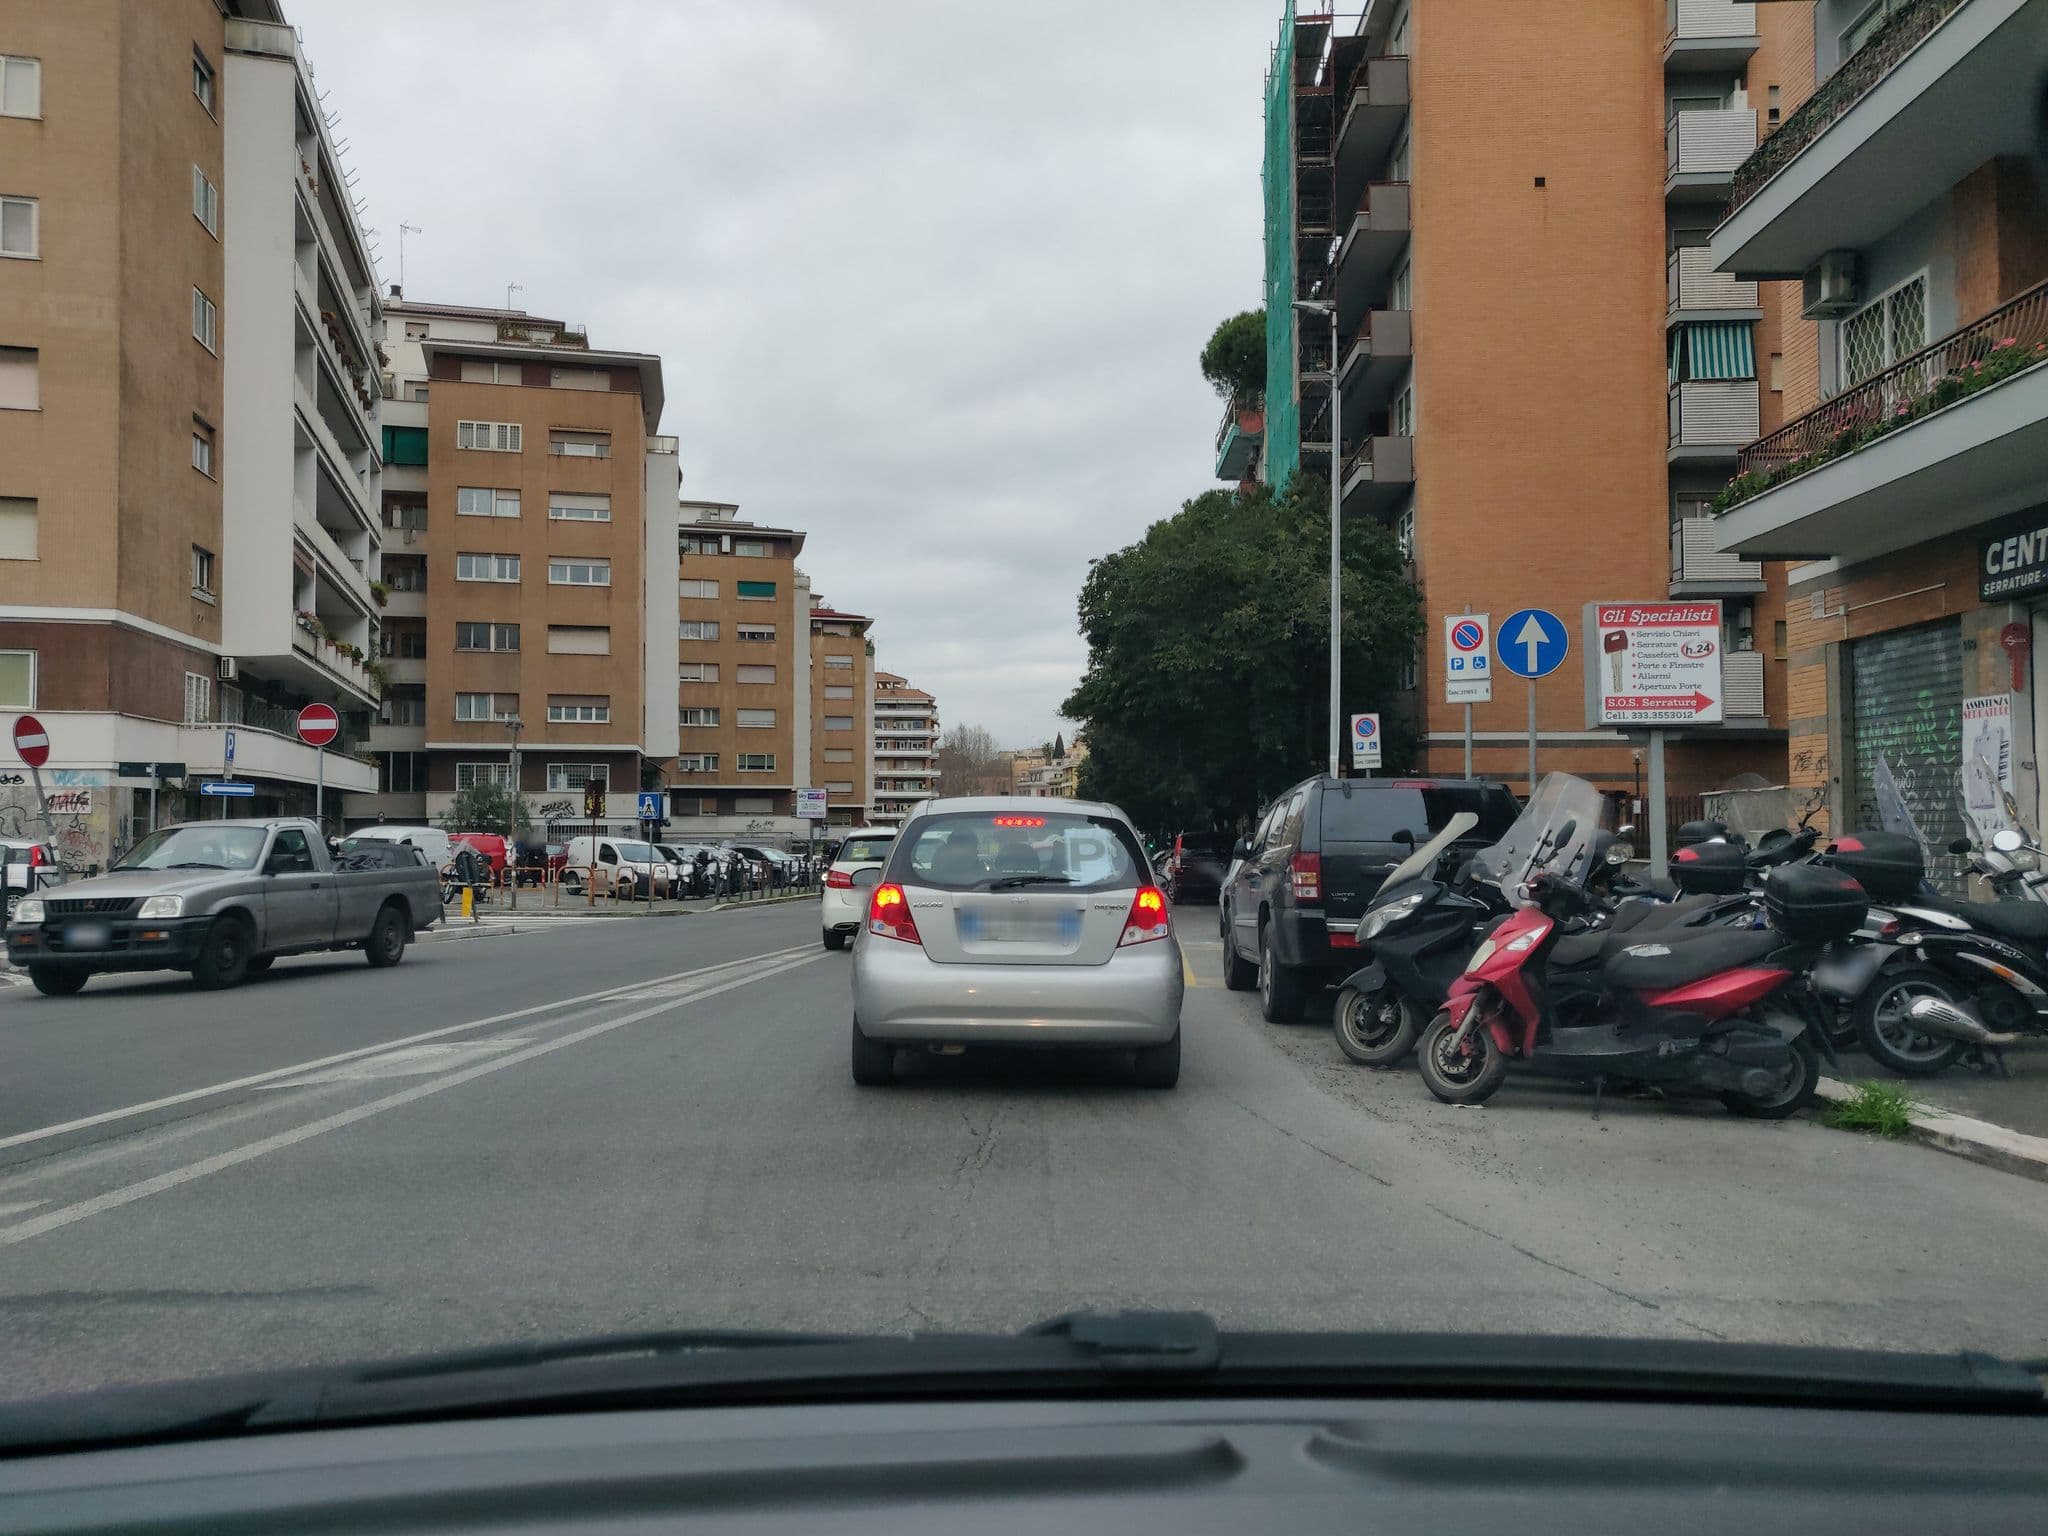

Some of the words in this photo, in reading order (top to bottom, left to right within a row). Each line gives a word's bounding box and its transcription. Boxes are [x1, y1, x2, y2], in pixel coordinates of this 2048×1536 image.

[1603, 609, 1626, 623] Gli
[1629, 608, 1714, 626] Specialisti
[1636, 630, 1671, 638] Servizio
[1685, 643, 1710, 655] h.24
[1608, 698, 1639, 707] S.O.S.
[1642, 698, 1697, 707] Serrature
[1605, 711, 1629, 720] Cell.
[1631, 711, 1694, 720] 333.3553012
